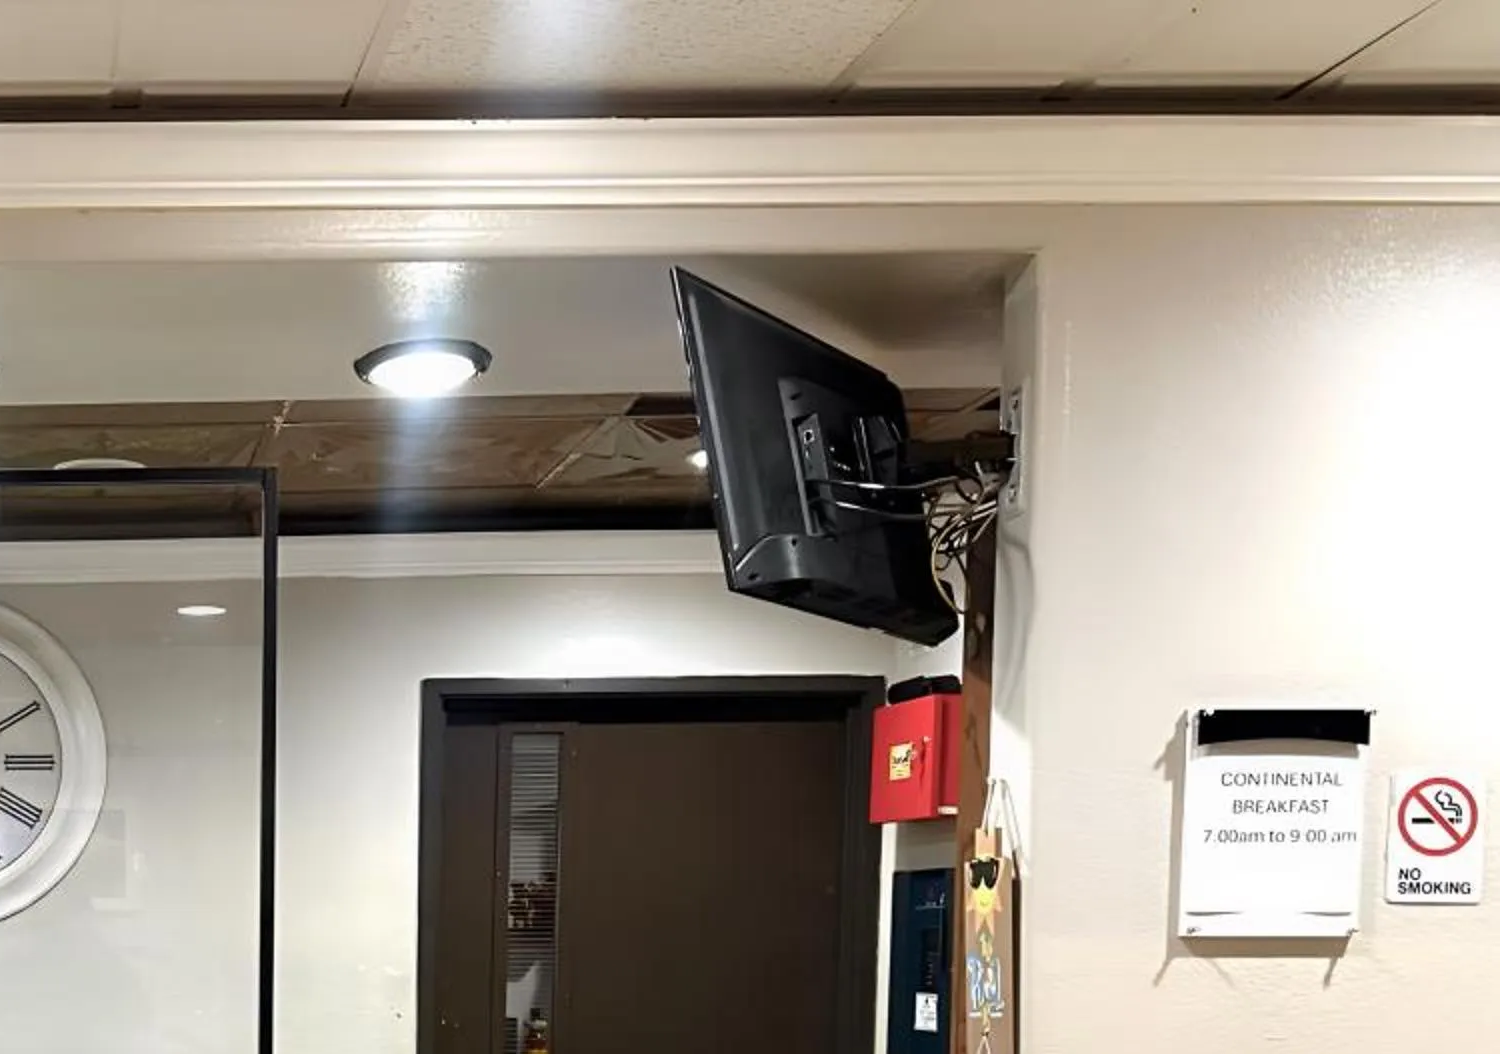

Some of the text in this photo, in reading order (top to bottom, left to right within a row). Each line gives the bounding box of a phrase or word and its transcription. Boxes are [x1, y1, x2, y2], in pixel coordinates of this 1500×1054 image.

[1220, 772, 1343, 787] CONTINENTAL
[1232, 799, 1329, 815] BREAKFAST
[1269, 830, 1285, 843] to
[1289, 829, 1327, 843] 900
[1398, 867, 1421, 880] NO
[1397, 881, 1471, 894] SMOKING
